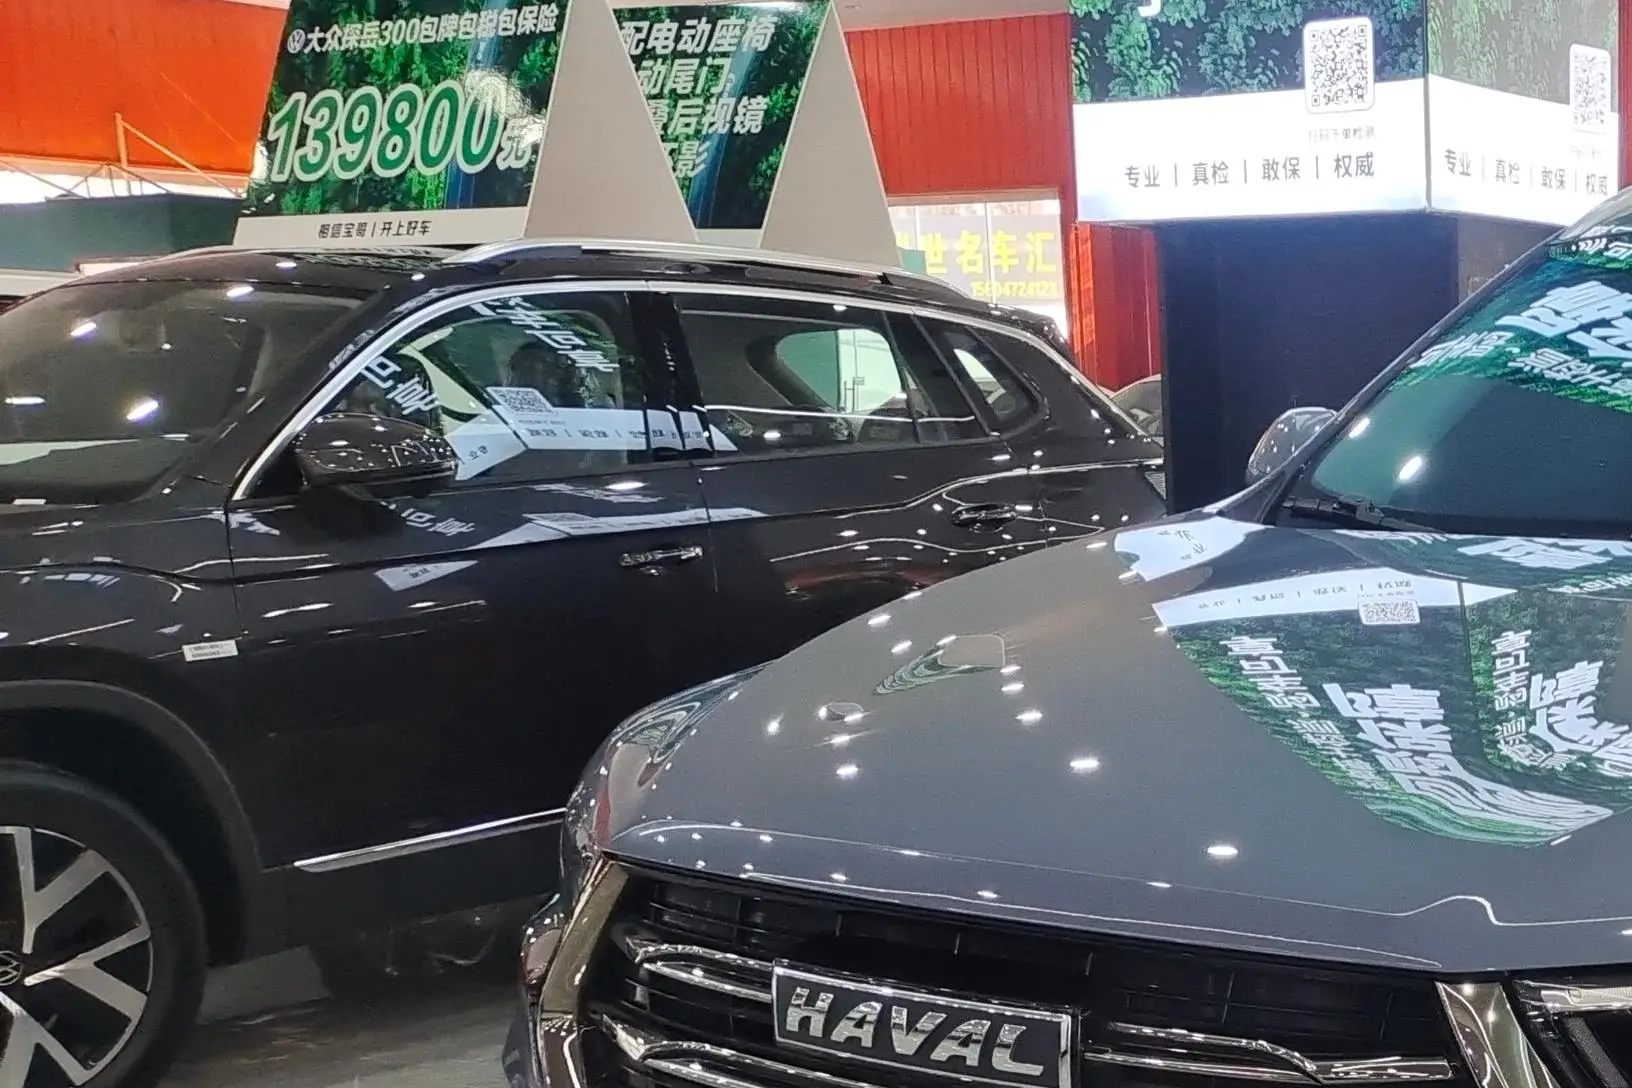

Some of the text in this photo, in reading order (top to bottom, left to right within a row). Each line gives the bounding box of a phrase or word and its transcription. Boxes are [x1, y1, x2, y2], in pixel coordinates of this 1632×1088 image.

[620, 15, 778, 55] 配电动座椅
[1125, 152, 1375, 188] 专业 真检 敢保 权威
[1444, 149, 1471, 176] 专业
[1541, 167, 1566, 190] 敢保
[380, 220, 432, 237] 开上好车
[786, 987, 1043, 1076] HAVAL
